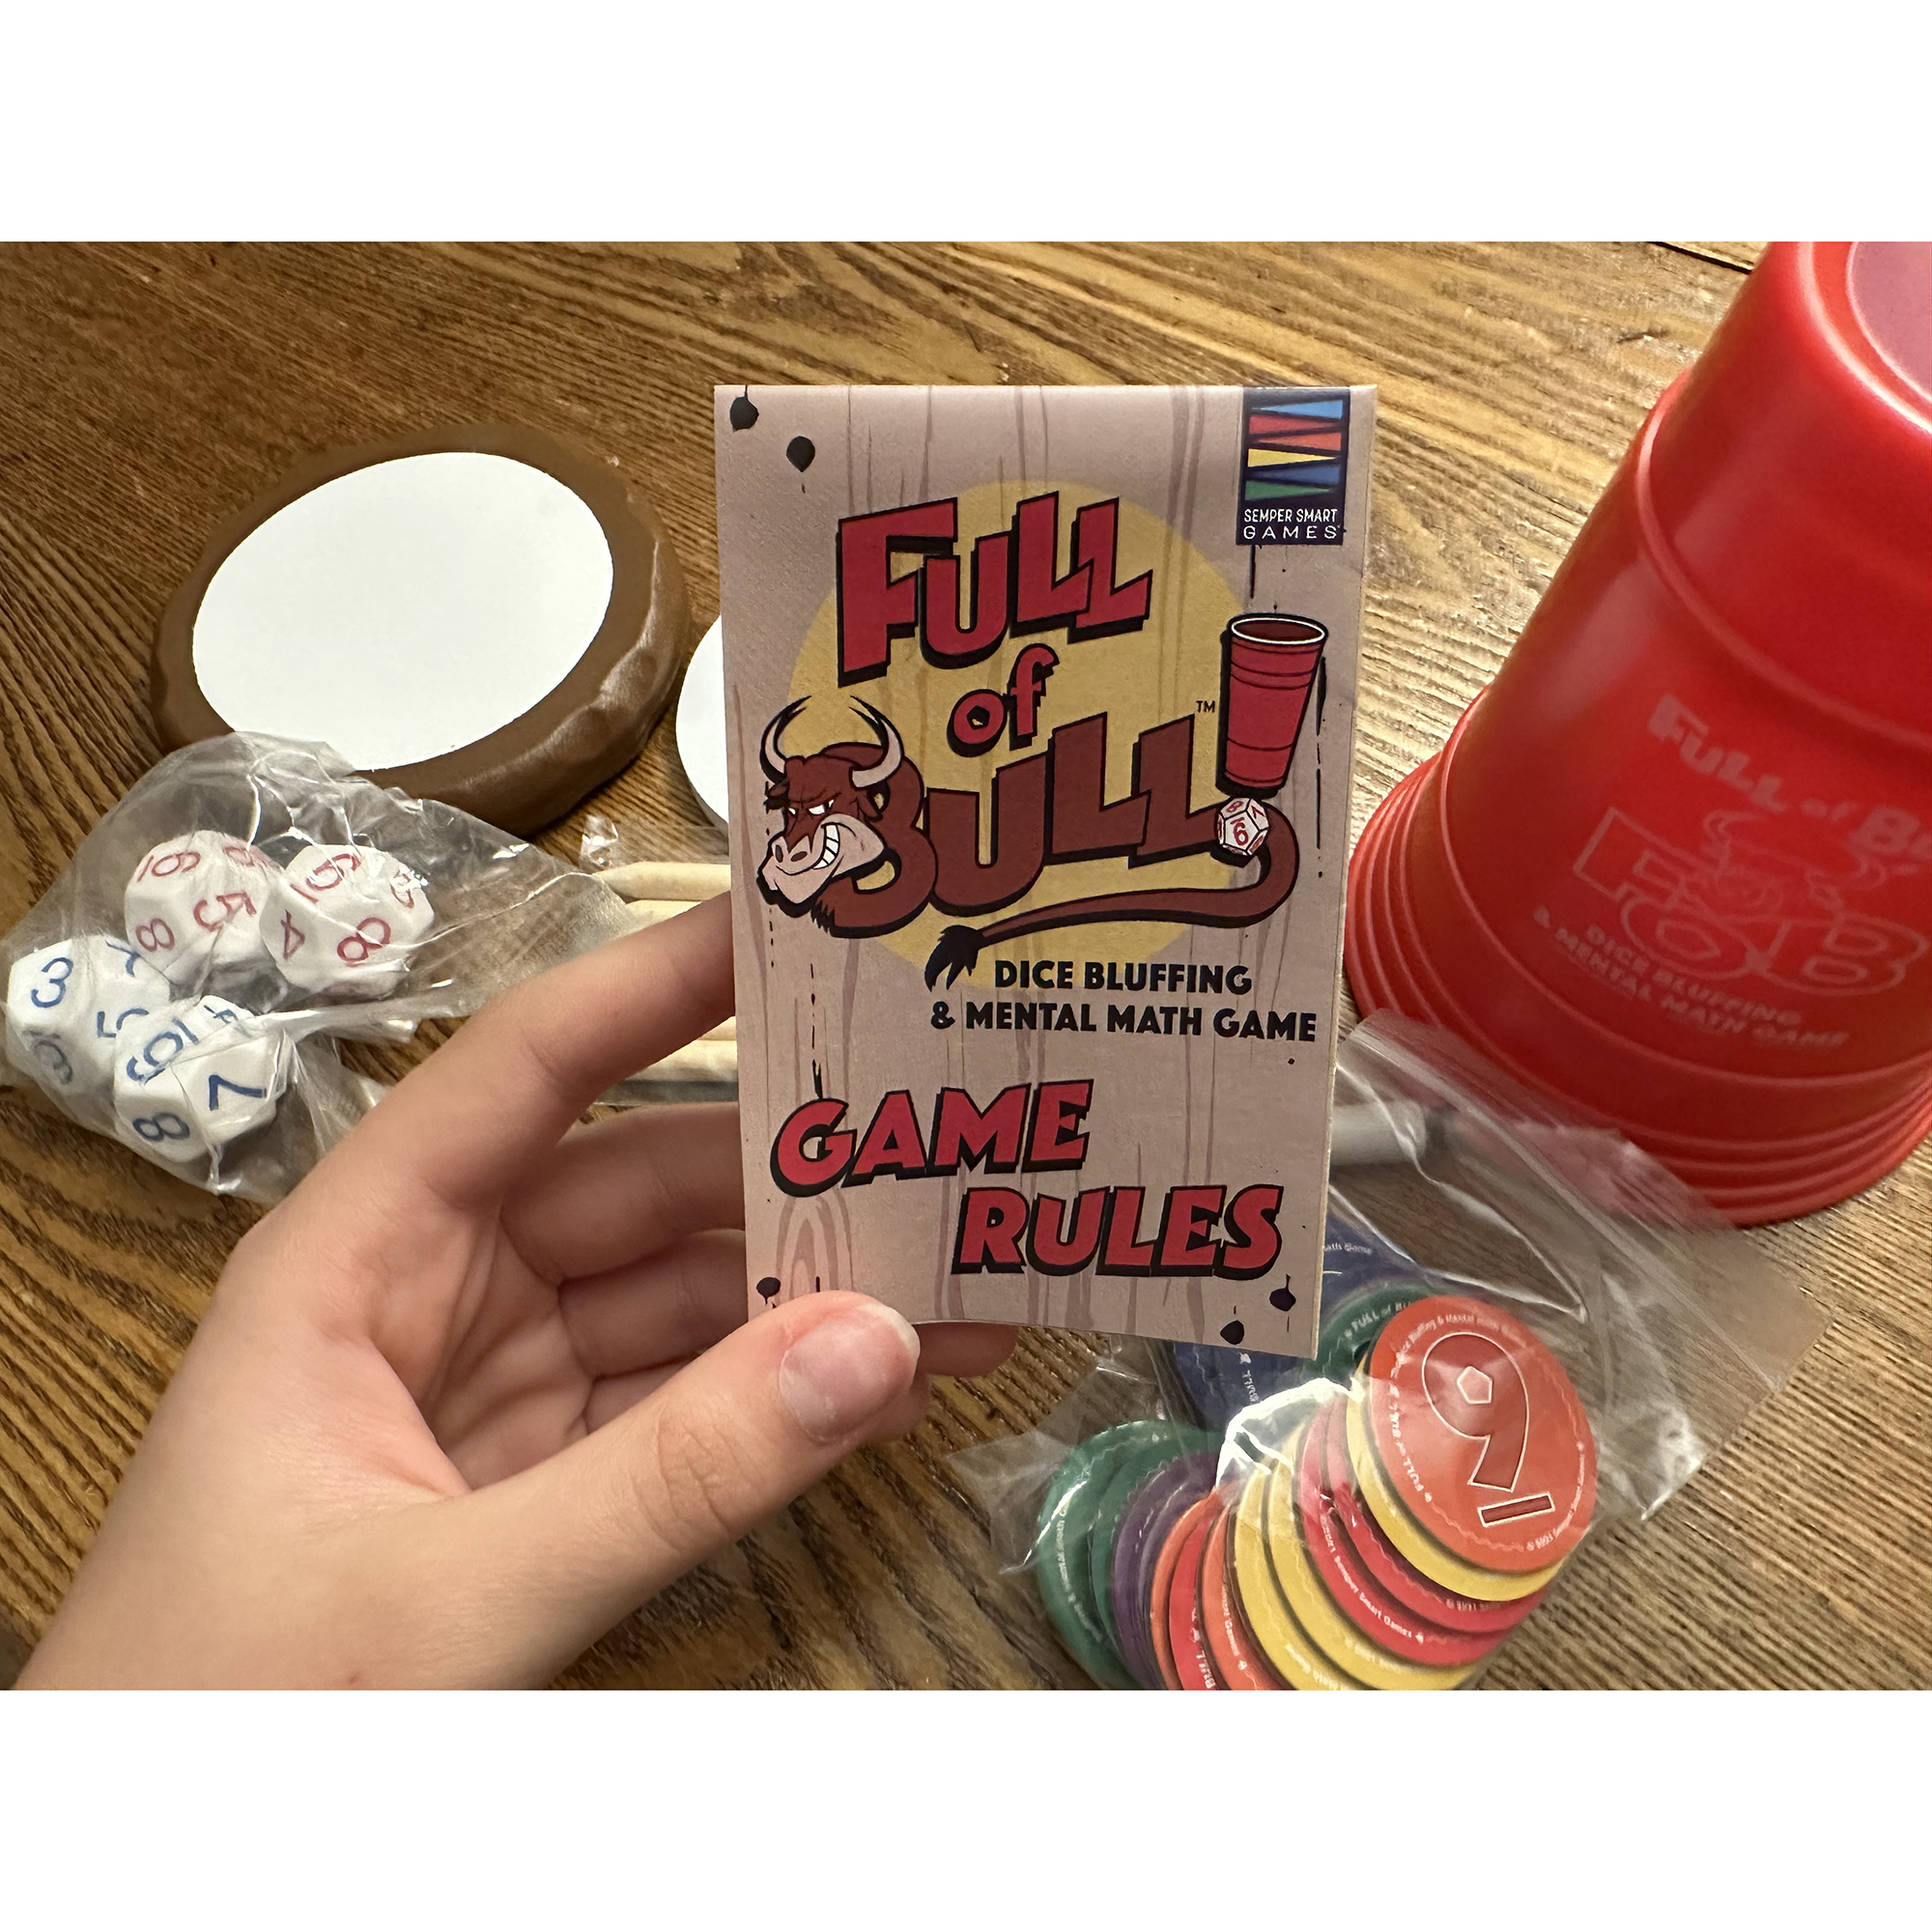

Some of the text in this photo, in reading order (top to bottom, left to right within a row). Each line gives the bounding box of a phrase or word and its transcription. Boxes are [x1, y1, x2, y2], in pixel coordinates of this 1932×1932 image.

[1243, 508, 1338, 523] SEMPER SMART
[1243, 525, 1337, 540] GAMES
[837, 491, 1152, 687] FULL
[947, 643, 1059, 757] of
[1647, 694, 1788, 812] FULL
[811, 712, 1225, 936] BULL
[135, 918, 175, 952] 8
[193, 891, 257, 932] 5
[280, 909, 305, 960] 4
[337, 917, 391, 966] 8
[31, 957, 74, 1009] 3
[994, 959, 1253, 996] DICE BLUFFING
[1586, 923, 1802, 1026] DICE BLUFFING
[930, 1001, 1318, 1043] & MENTAL MATH GAME
[209, 1074, 268, 1112] 7
[132, 1112, 191, 1143] 8
[770, 1078, 1094, 1198] GAME
[951, 1184, 1284, 1281] RULES
